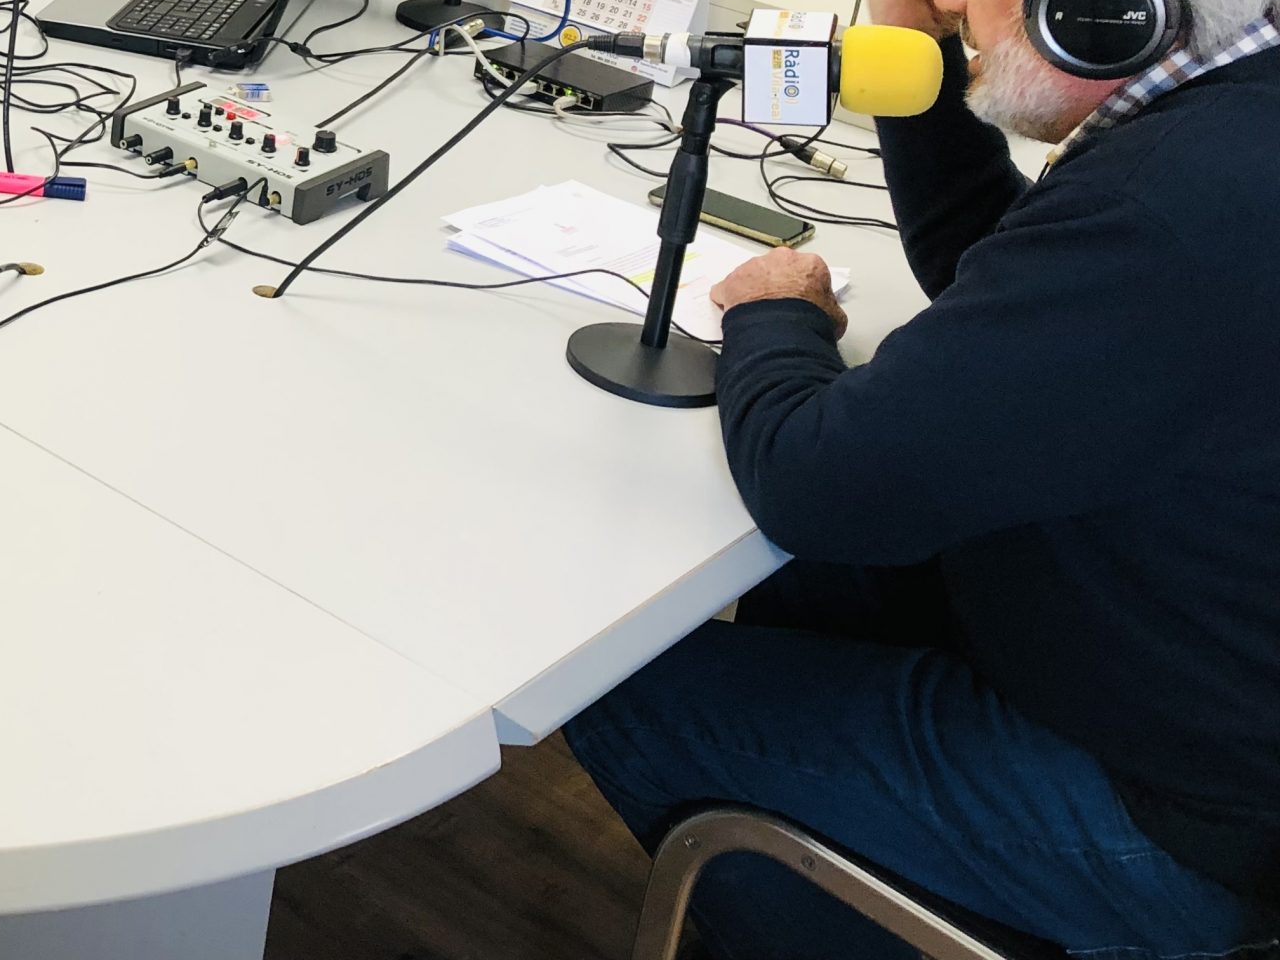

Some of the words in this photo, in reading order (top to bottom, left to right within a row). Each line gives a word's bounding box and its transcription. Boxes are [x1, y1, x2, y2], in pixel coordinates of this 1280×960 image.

[596, 1, 606, 10] 19
[609, 5, 619, 14] 20
[622, 9, 633, 18] 21
[1123, 11, 1147, 20] JVC
[576, 8, 587, 17] 25
[590, 12, 601, 21] 26
[604, 16, 615, 25] 27
[617, 20, 628, 29] 28
